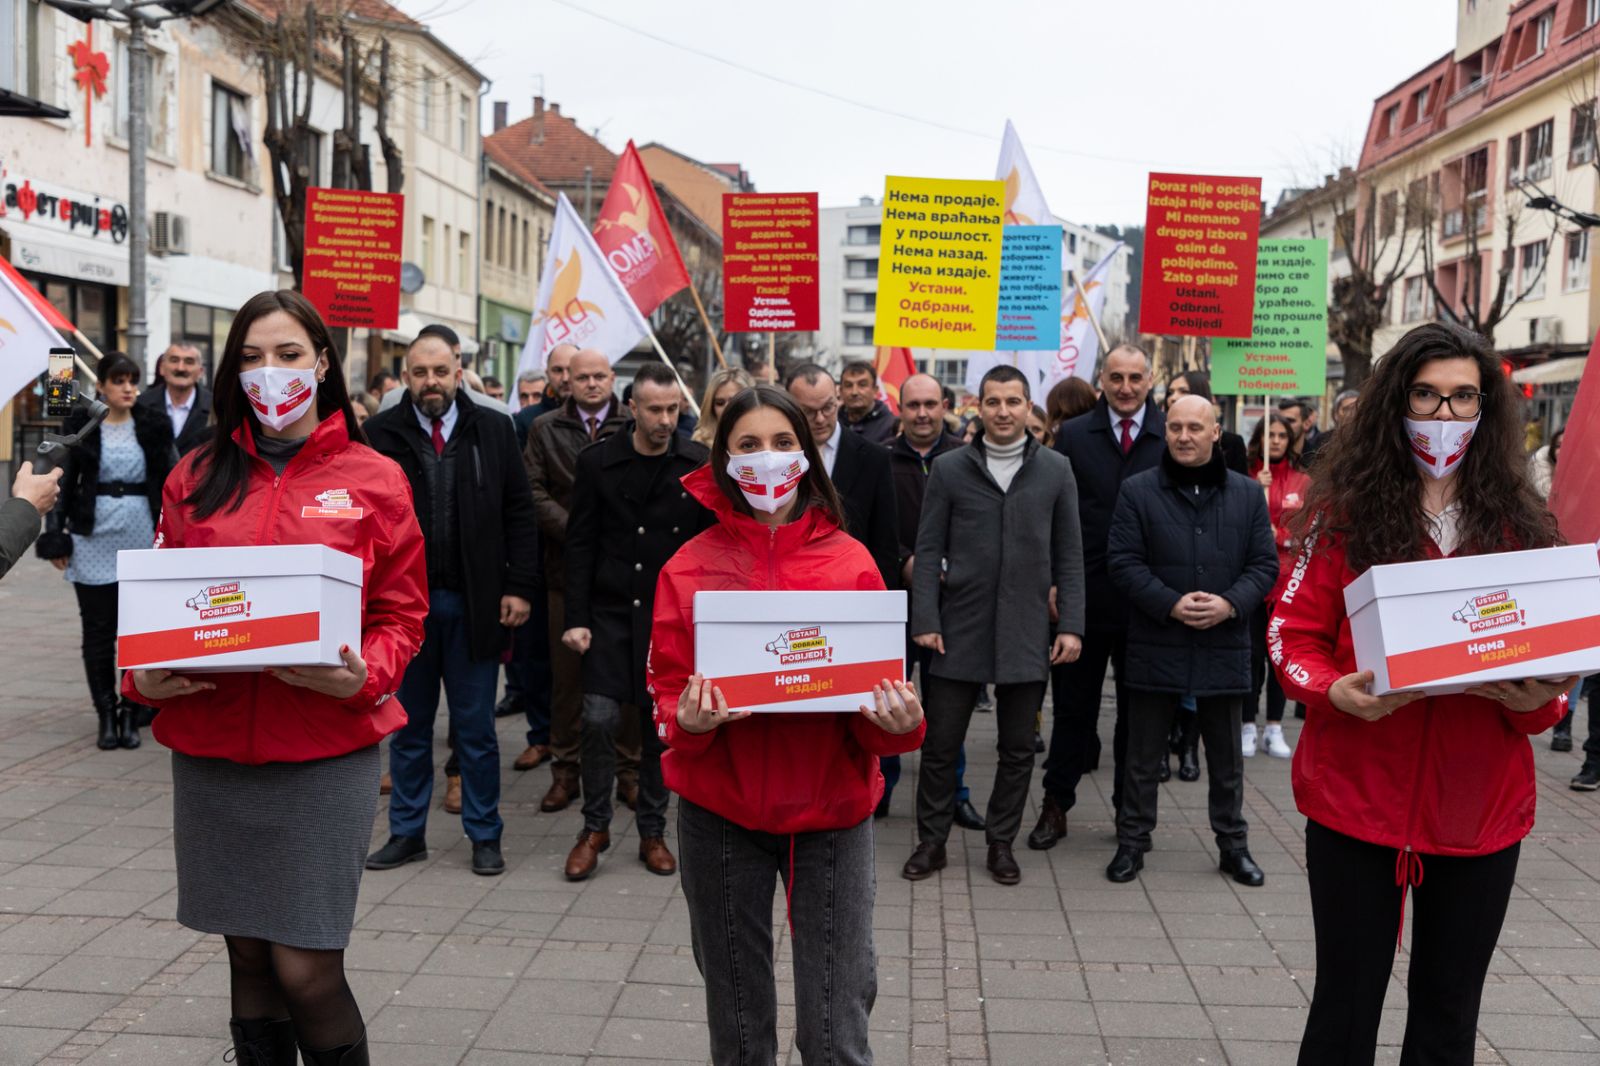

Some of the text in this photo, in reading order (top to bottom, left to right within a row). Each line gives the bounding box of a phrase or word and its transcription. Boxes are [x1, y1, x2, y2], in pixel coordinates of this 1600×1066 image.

[1151, 180, 1259, 197] Poraz nije opcija.
[733, 196, 776, 206] Бранимо
[889, 190, 1000, 208] Нема продаје.
[1150, 196, 1260, 212] Izdaja nije opcija.
[728, 208, 772, 217] Бранимо
[886, 208, 1000, 225] Нема враћања
[1166, 211, 1240, 225] Mi nemamo
[731, 218, 774, 229] Бранимо
[896, 228, 992, 242] у прошлост.
[1156, 226, 1248, 240] drugog izbora
[736, 241, 779, 251] Бранимо
[1176, 243, 1226, 254] osim da
[1282, 244, 1305, 253] смо
[893, 244, 933, 258] Нема
[938, 248, 988, 261] назад.
[1161, 256, 1238, 270] pobijedimo.
[1272, 258, 1316, 268] издаје.
[892, 262, 932, 275] Нема
[937, 266, 991, 280] издаје.
[1288, 272, 1310, 280] све
[1163, 271, 1238, 287] Zato glasaj!
[909, 281, 967, 296] Устани.
[1176, 288, 1220, 299] Ustani.
[1282, 286, 1298, 294] до
[753, 297, 790, 306] Устани.
[900, 298, 974, 314] Одбрани.
[1259, 298, 1315, 309] урађено.
[748, 308, 796, 318] Одбрани.
[1170, 302, 1224, 314] Odbrani.
[1170, 316, 1222, 330] Pobijedi
[1274, 312, 1323, 322] прошле
[748, 318, 796, 329] Побиједи
[898, 316, 976, 332] Побиједи.
[1227, 339, 1313, 349] нижемо нове.
[1245, 353, 1291, 362] Устани.
[1238, 366, 1297, 377] Одбрани.
[1238, 380, 1300, 390] Побиједи.
[210, 584, 237, 594] USTANI
[212, 595, 242, 604] ODBRANI
[1477, 593, 1506, 605] USTANI
[1480, 603, 1512, 616] ODBRANI
[194, 628, 228, 641] Нема
[790, 630, 818, 638] USTANI
[204, 633, 251, 648] издаје!
[792, 640, 822, 649] ODBRANI
[1467, 640, 1505, 656] Нема
[1481, 642, 1532, 662] издаје!
[775, 674, 810, 686] Нема
[786, 678, 833, 694] издаје!
